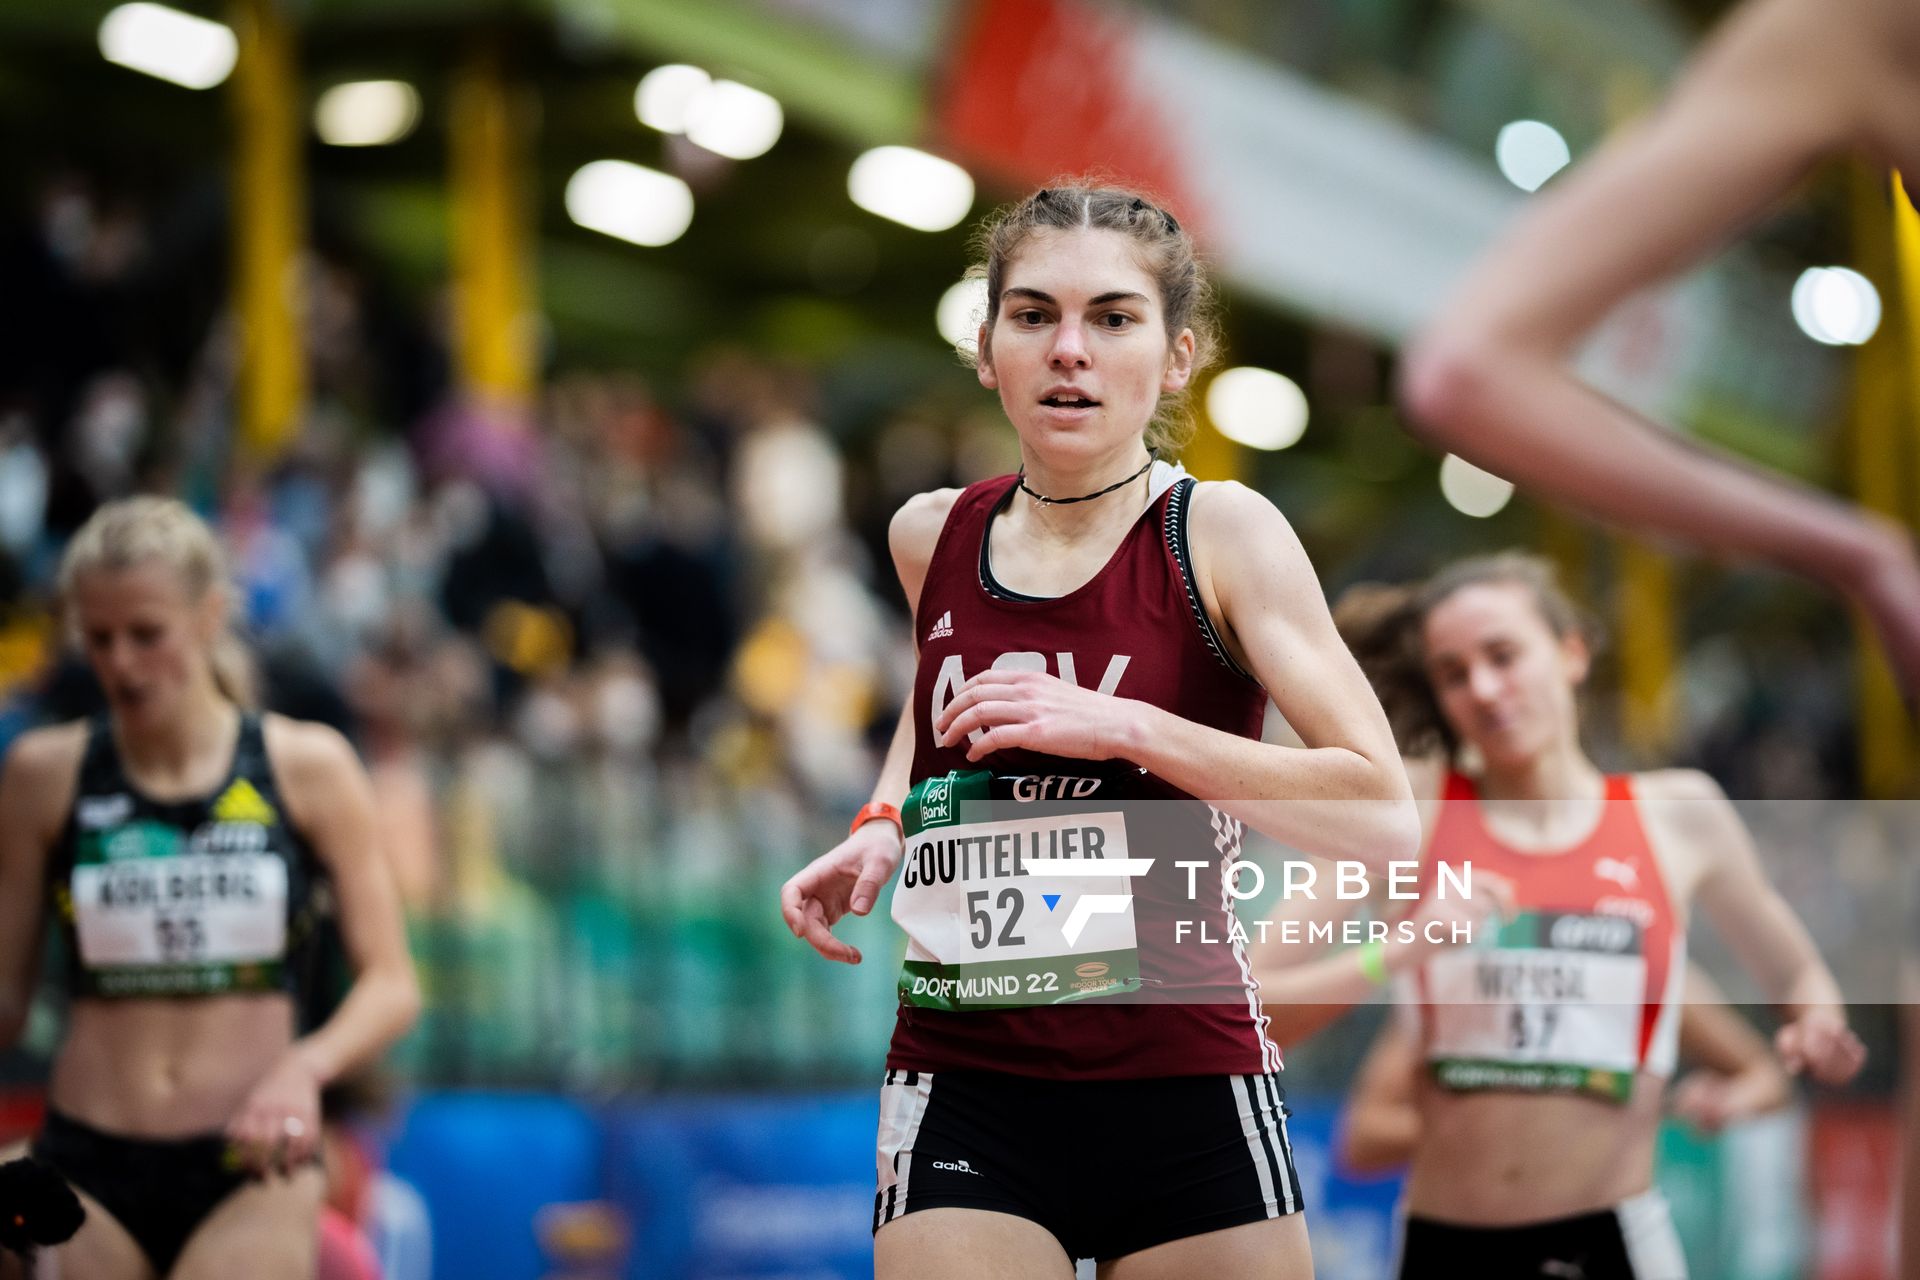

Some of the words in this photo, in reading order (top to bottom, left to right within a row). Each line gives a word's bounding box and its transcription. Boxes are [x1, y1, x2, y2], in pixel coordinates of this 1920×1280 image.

[928, 628, 954, 641] adidas
[922, 802, 948, 821] Bank
[967, 887, 1026, 950] 52
[912, 976, 1020, 999] DORTMUND
[1026, 972, 1059, 994] 22
